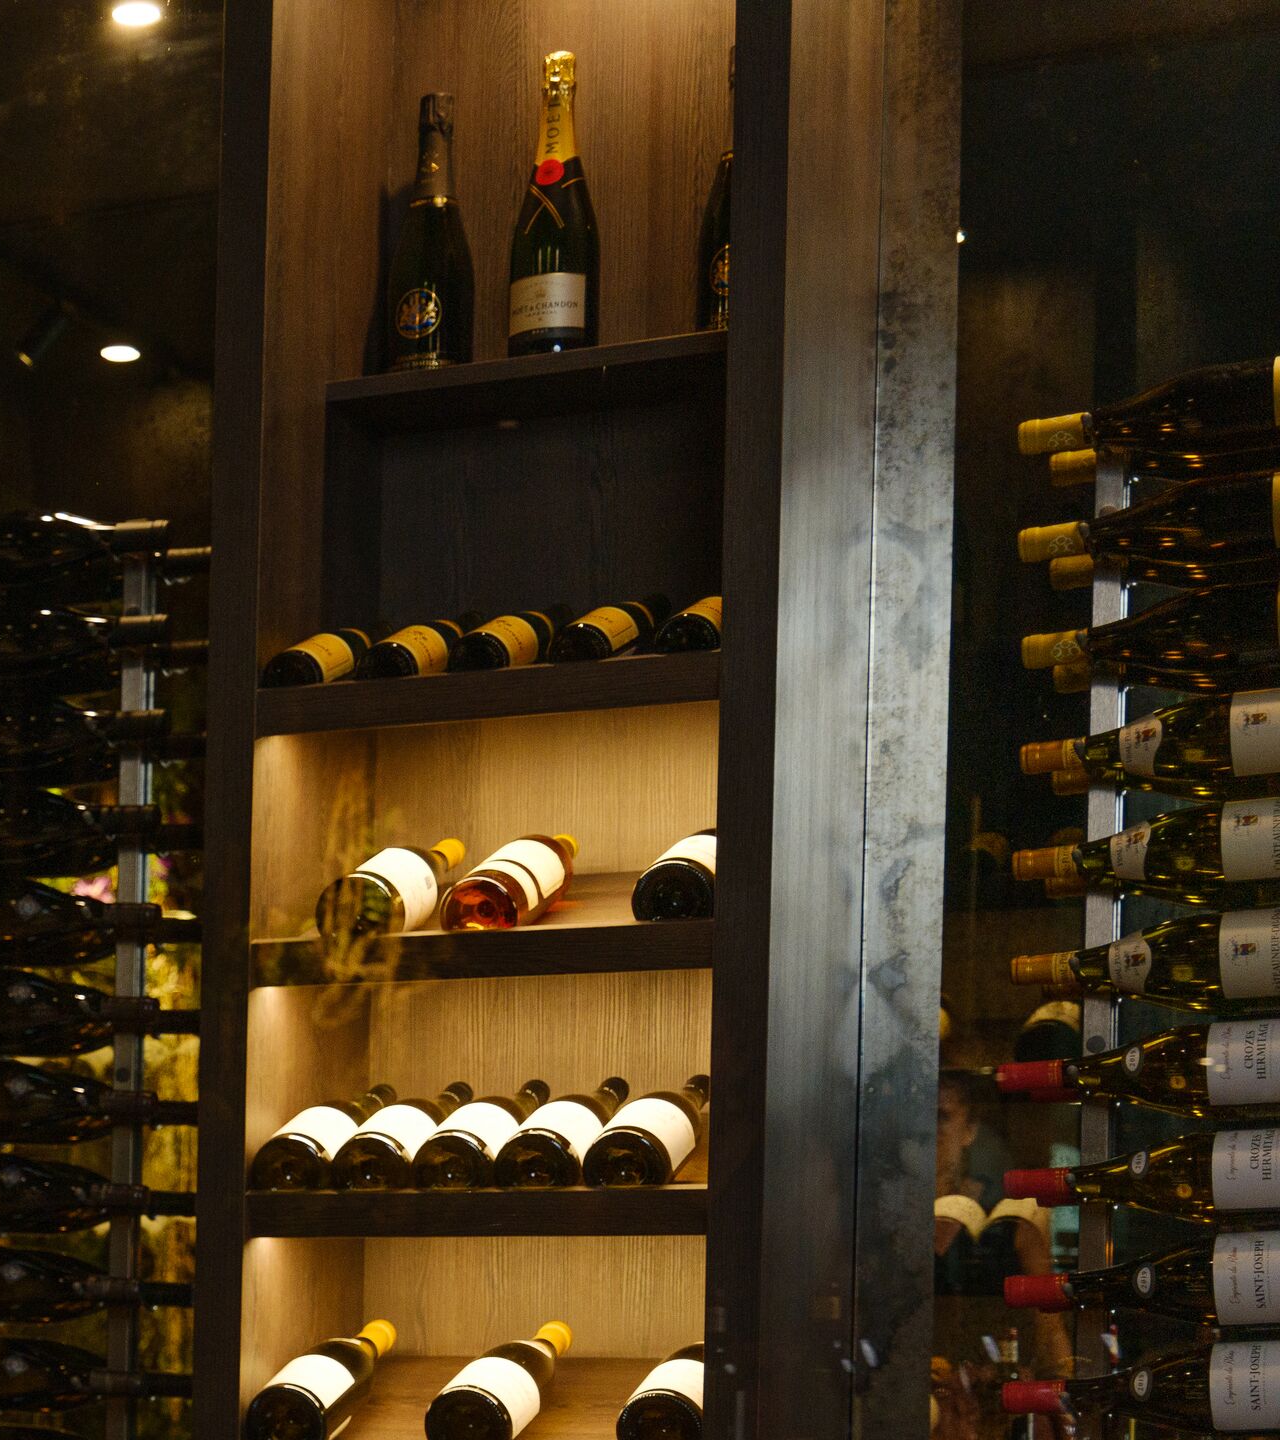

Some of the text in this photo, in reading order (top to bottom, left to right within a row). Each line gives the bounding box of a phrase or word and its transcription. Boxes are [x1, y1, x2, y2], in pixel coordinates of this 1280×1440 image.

[1243, 1030, 1255, 1069] CROZES
[1250, 1134, 1262, 1170] CROZES
[1254, 1240, 1265, 1309] SAINT-JOSEPH
[1249, 1343, 1261, 1411] SAINT-JOSEPH
